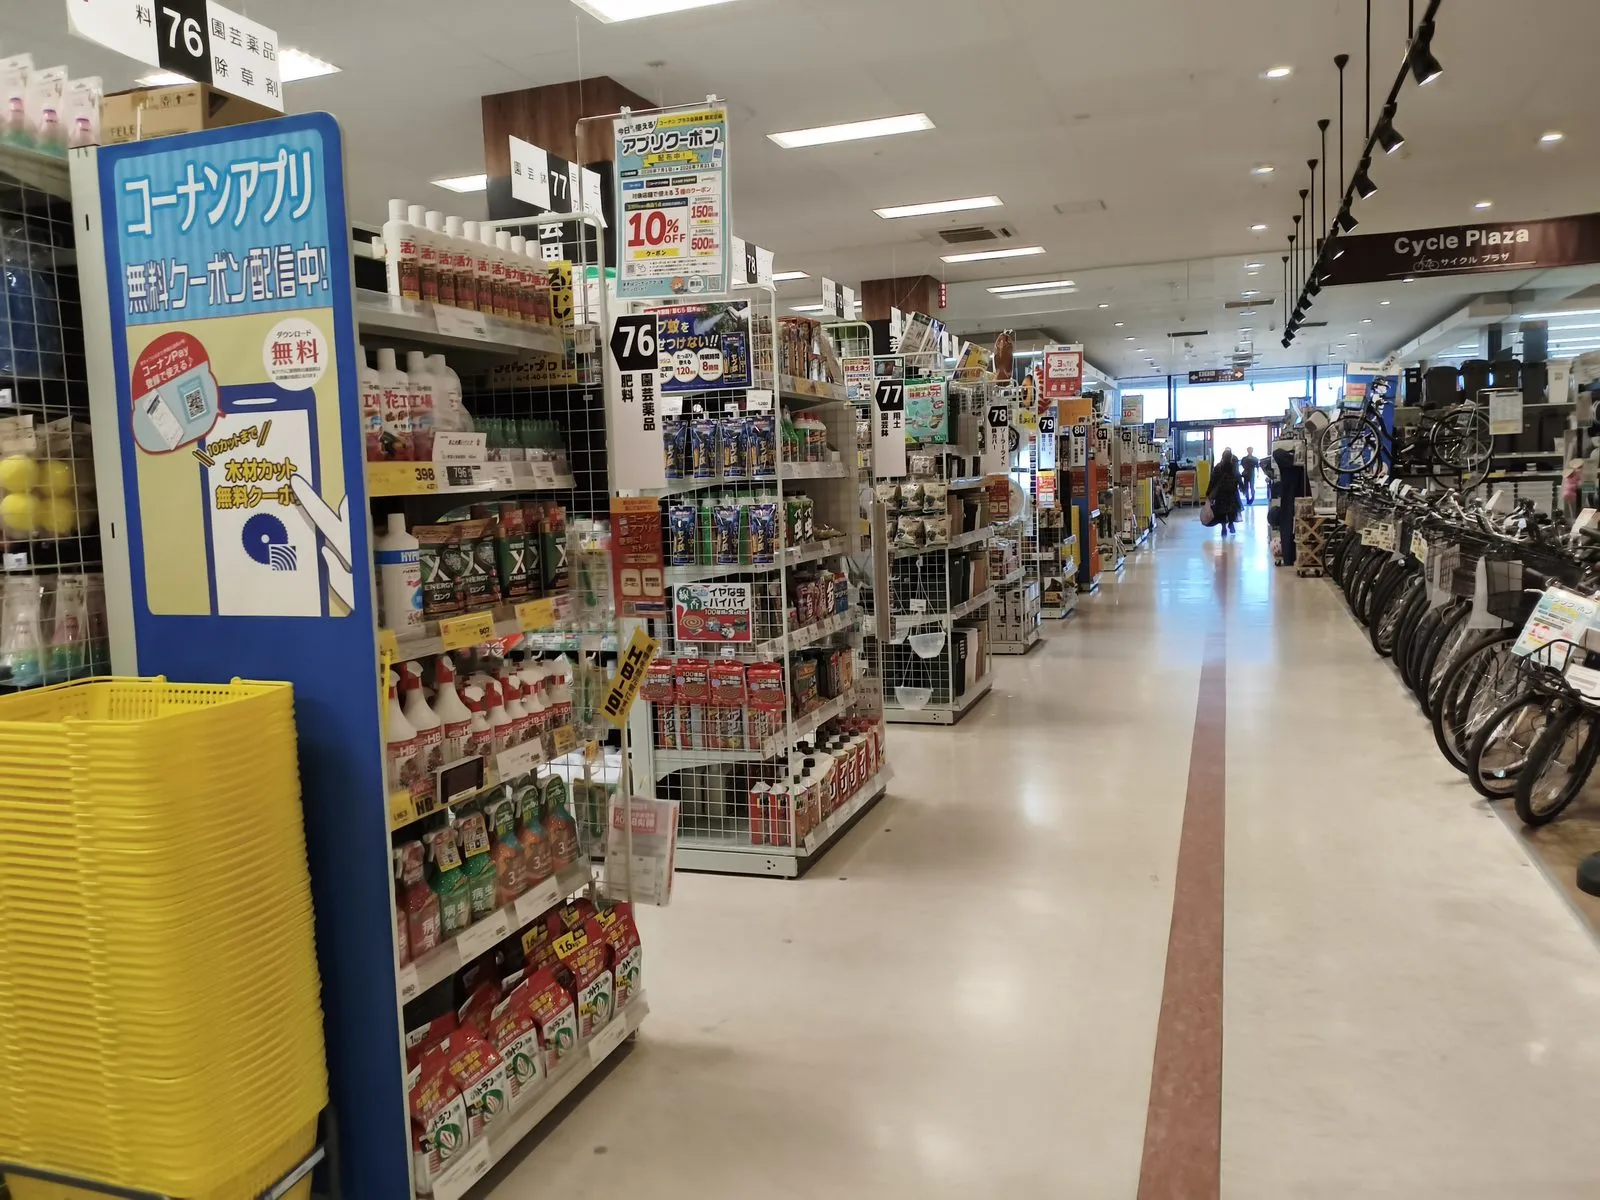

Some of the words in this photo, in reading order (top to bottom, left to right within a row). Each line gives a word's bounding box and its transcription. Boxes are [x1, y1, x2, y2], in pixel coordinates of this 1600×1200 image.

[162, 6, 204, 58] 76
[211, 17, 276, 62] 園芸薬品
[214, 56, 279, 98] 除草剤
[623, 128, 719, 154] アプリクーポン
[124, 148, 314, 235] コーナンアプリ
[551, 170, 567, 199] 77
[628, 211, 679, 247] 10%
[664, 234, 686, 244] OFF
[1394, 235, 1459, 258] Cycle
[1465, 227, 1530, 248] Plaza
[747, 255, 756, 275] 78
[1441, 255, 1478, 266] サイクル
[1482, 252, 1510, 263] プラザ
[126, 242, 329, 314] 無料クーポン配信中!
[277, 329, 312, 339] ダウンロード
[619, 324, 655, 357] 76
[142, 346, 189, 378] コーナンPay
[271, 338, 319, 366] 無料
[621, 374, 633, 403] 肥料
[881, 386, 902, 404] 77
[641, 373, 655, 431] 園芸薬品
[893, 412, 900, 428] 用土
[992, 410, 1006, 422] 78
[1042, 420, 1053, 429] 79
[207, 426, 258, 457] 10カットまで
[1074, 426, 1084, 434] 80
[225, 458, 297, 483] 木材カット
[415, 468, 435, 481] 398
[630, 515, 658, 523] コーナン
[461, 551, 486, 576] X
[510, 550, 526, 574] X
[424, 582, 454, 591] ENERGY
[470, 586, 486, 594] ロング
[710, 588, 745, 597] イヤな虫
[850, 754, 857, 786] アリ
[860, 747, 866, 779] アリ
[840, 761, 848, 793] アリ
